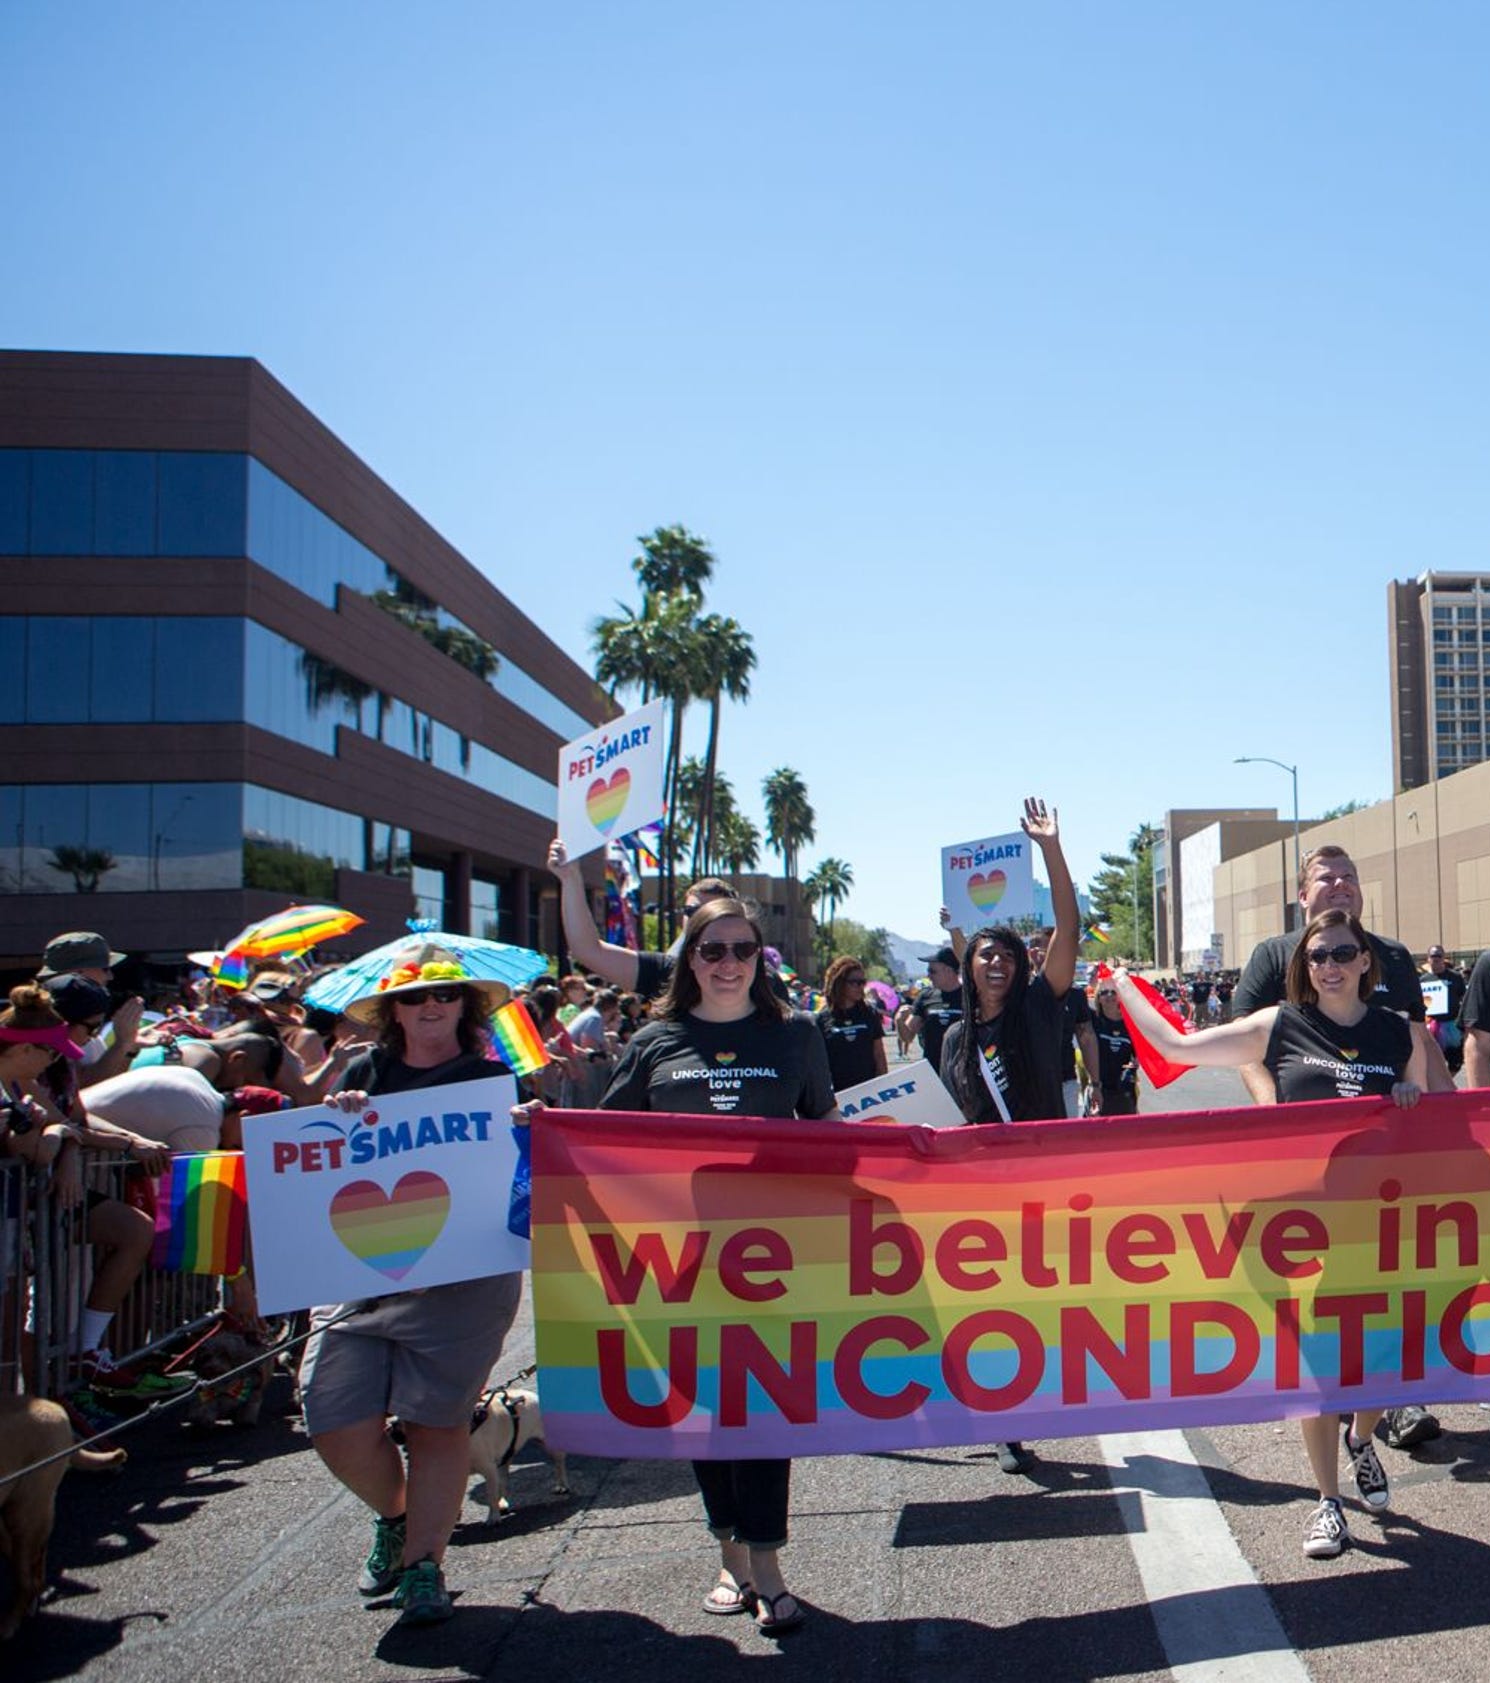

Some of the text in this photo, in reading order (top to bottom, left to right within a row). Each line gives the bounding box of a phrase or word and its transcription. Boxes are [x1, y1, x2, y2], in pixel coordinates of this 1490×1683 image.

[569, 725, 651, 781] PETSMART
[949, 843, 1022, 871] PETSMART
[672, 1067, 778, 1080] UNCONDITIONAL
[1303, 1055, 1395, 1076] UNCONDITIONAL
[1335, 1068, 1365, 1081] love
[708, 1077, 742, 1090] love
[273, 1111, 493, 1174] PETSMART
[588, 1178, 1480, 1305] we believe in
